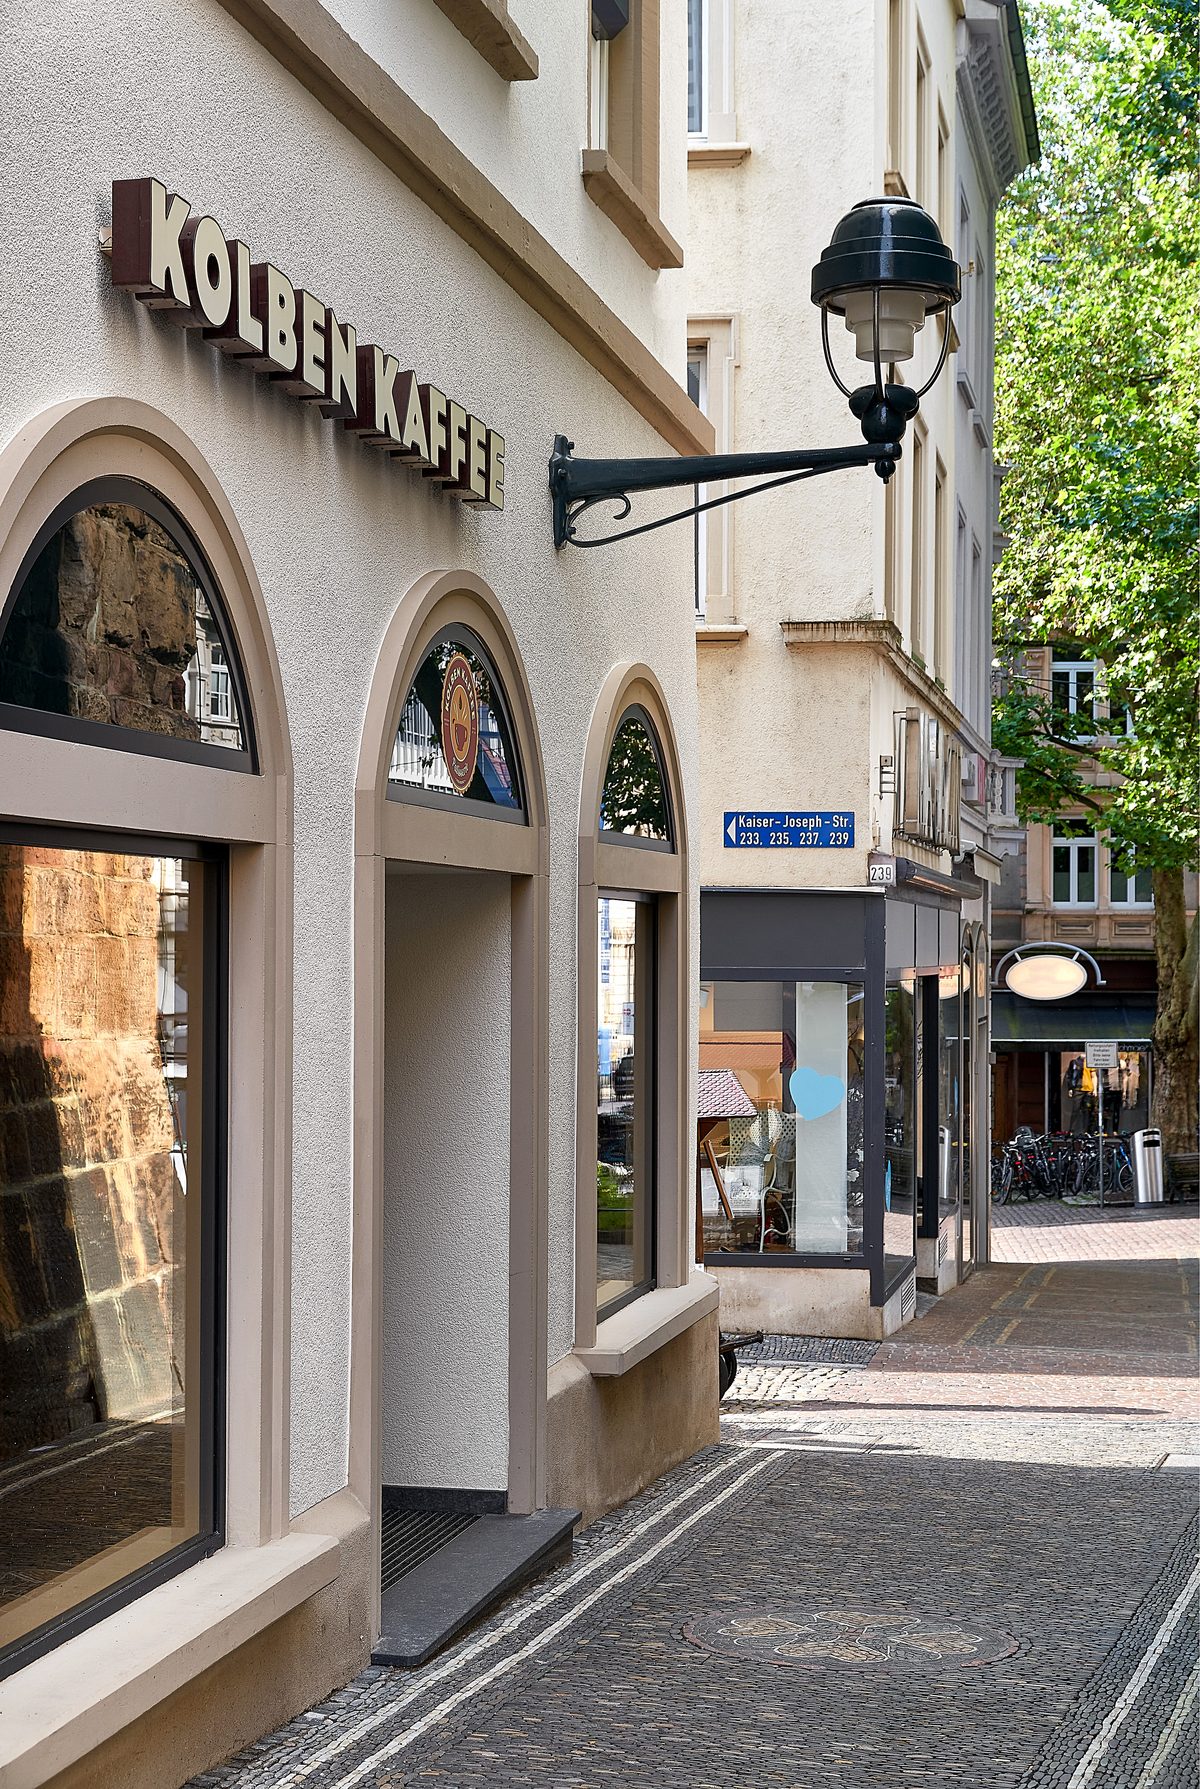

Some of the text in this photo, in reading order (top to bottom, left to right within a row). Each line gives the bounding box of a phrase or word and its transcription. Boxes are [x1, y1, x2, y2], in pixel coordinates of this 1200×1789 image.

[149, 176, 506, 512] KOLBEN KAFFEE
[738, 814, 852, 830] Kaiser-Joseph-Str.
[829, 832, 849, 845] 239
[870, 866, 892, 881] 239
